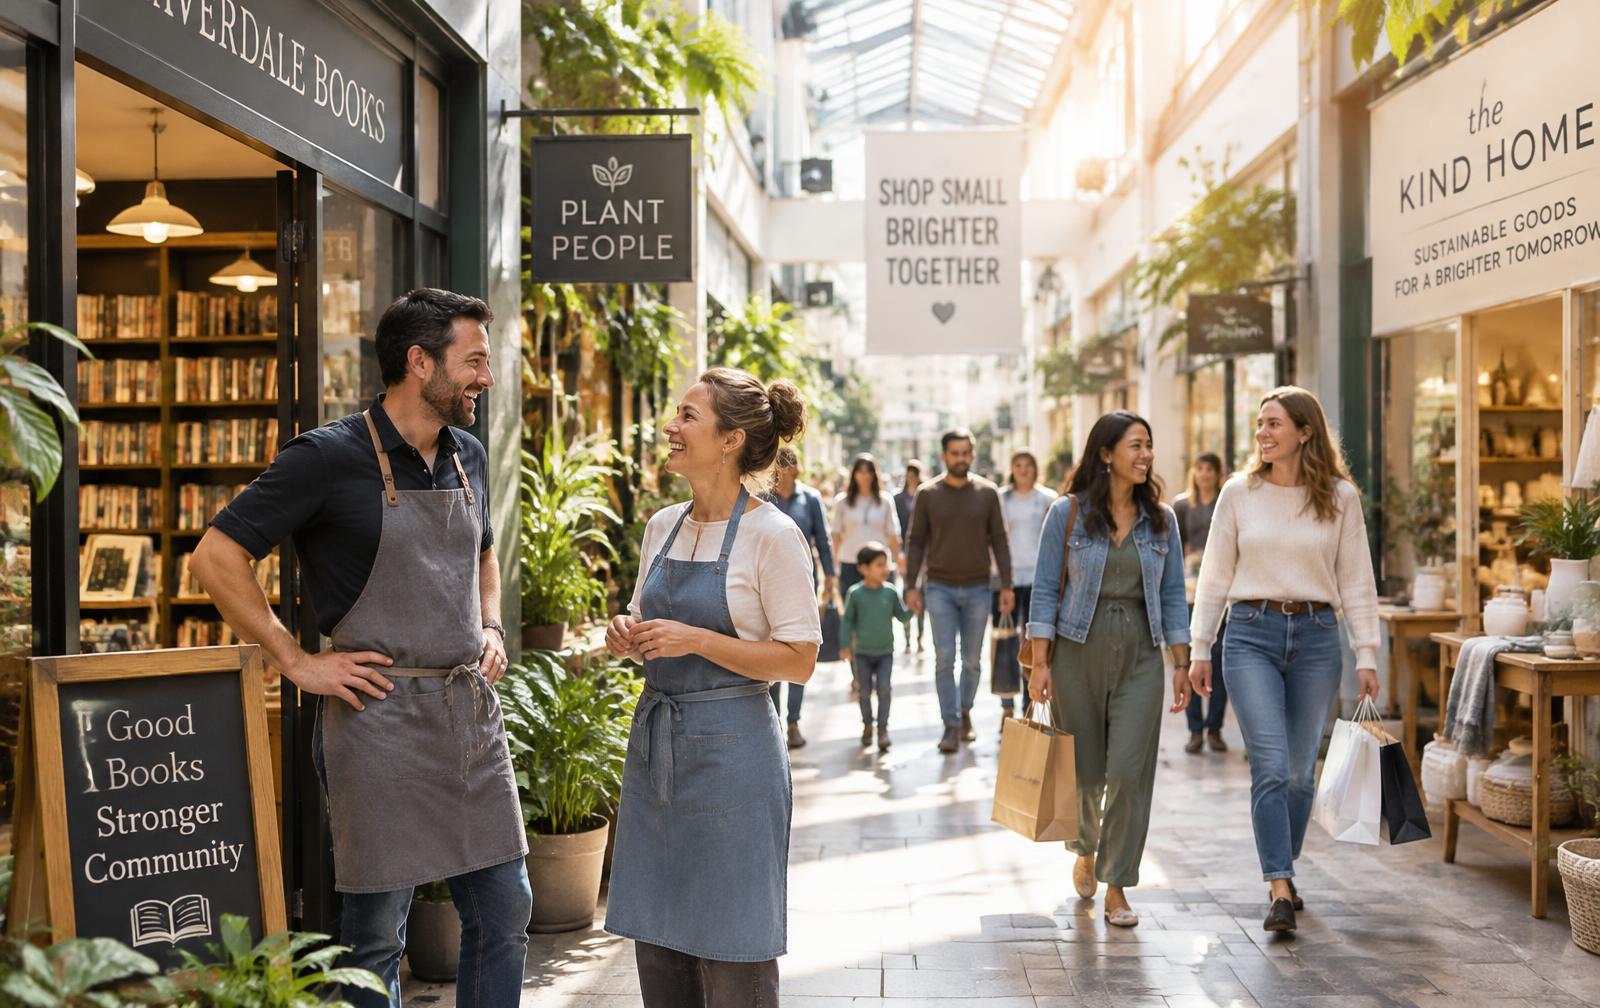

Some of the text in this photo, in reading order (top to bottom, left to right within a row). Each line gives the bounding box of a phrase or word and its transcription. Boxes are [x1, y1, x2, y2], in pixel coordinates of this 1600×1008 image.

[153, 0, 385, 143] ERDALE BOOKS
[1468, 76, 1504, 135] the
[1400, 102, 1595, 214] KIND HOME
[879, 178, 1007, 206] SHOP SMALL
[562, 200, 665, 225] PLANT
[885, 217, 1000, 245] BRIGHTER
[1414, 196, 1577, 266] SUSTAINABLE GOODS
[552, 235, 674, 261] PEOPLE
[1395, 220, 1600, 298] FOR A BRIGHTER TOMORROW
[886, 257, 1001, 285] TOGETHER
[106, 704, 196, 742] Good
[106, 752, 205, 791] Books
[97, 802, 223, 838] Stronger
[84, 840, 244, 884] Community
